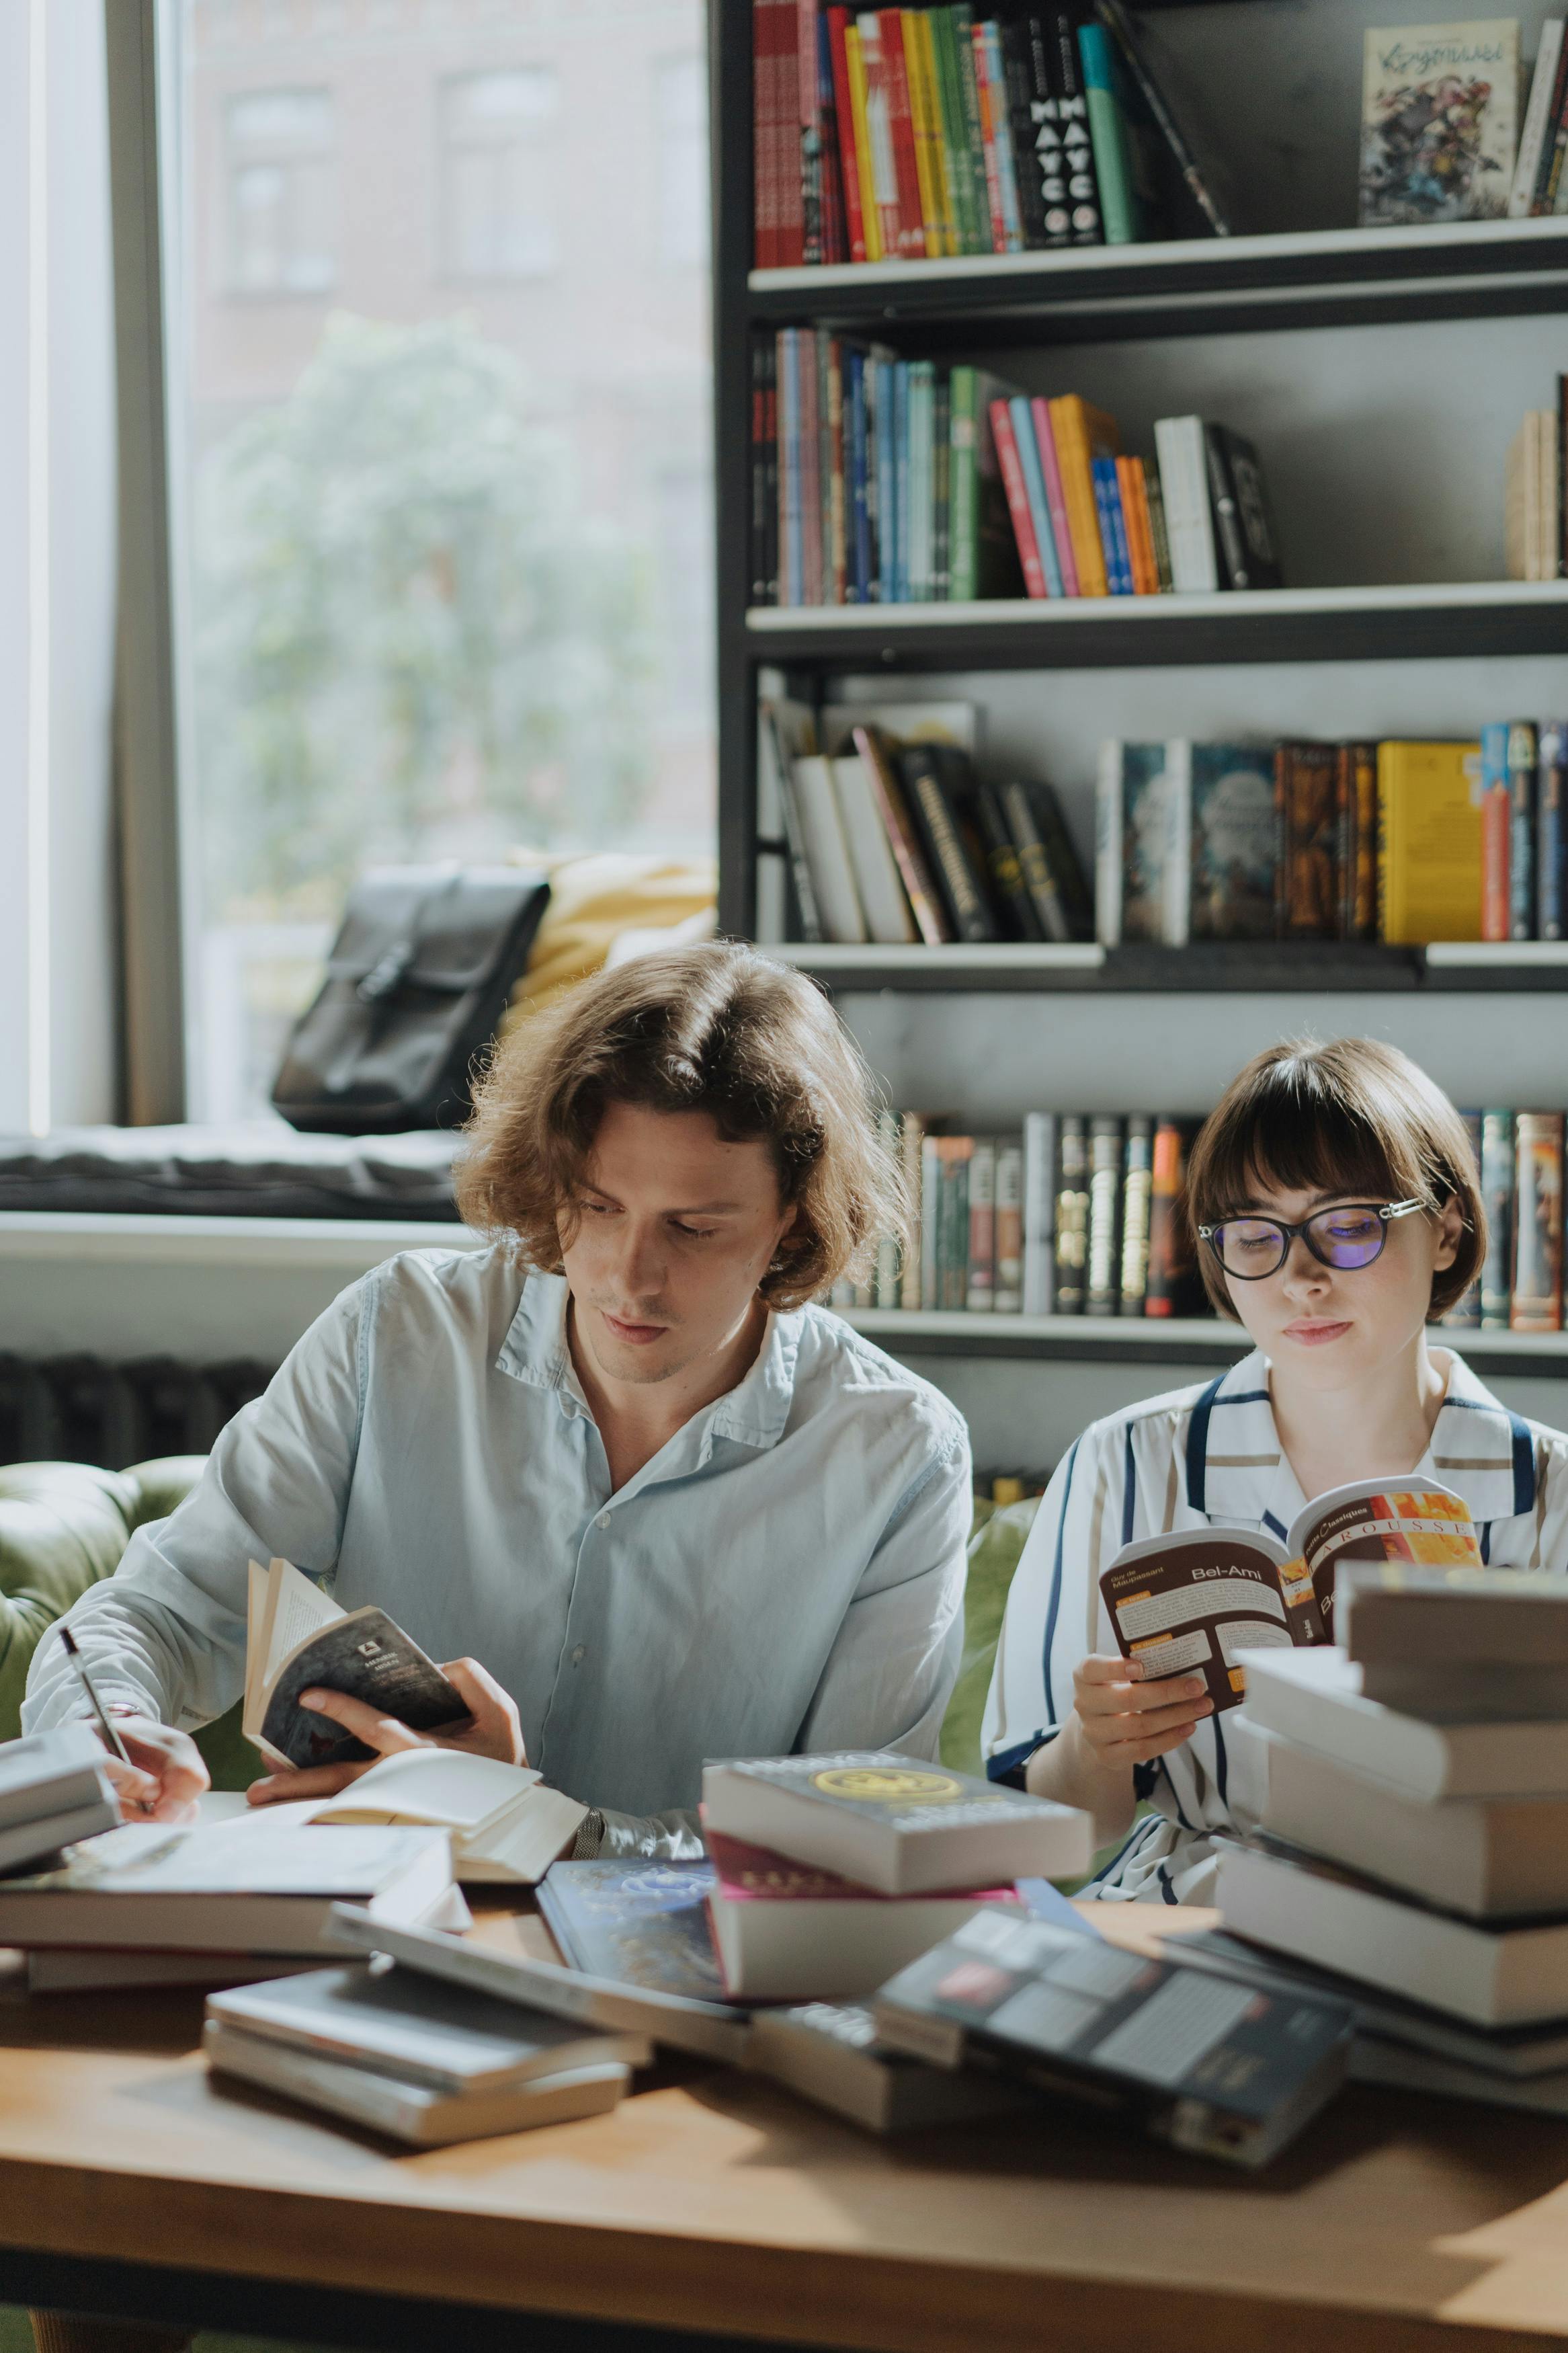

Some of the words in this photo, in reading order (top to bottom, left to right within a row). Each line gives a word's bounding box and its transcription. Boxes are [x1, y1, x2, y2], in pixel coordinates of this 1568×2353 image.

[1320, 1507, 1368, 1538] Classiques
[1309, 1519, 1468, 1573] LAROUSSE
[1111, 1571, 1125, 1583] Guy
[1126, 1569, 1136, 1577] de
[1112, 1566, 1164, 1589] Maupassant
[1191, 1565, 1262, 1580] Bel-Ami
